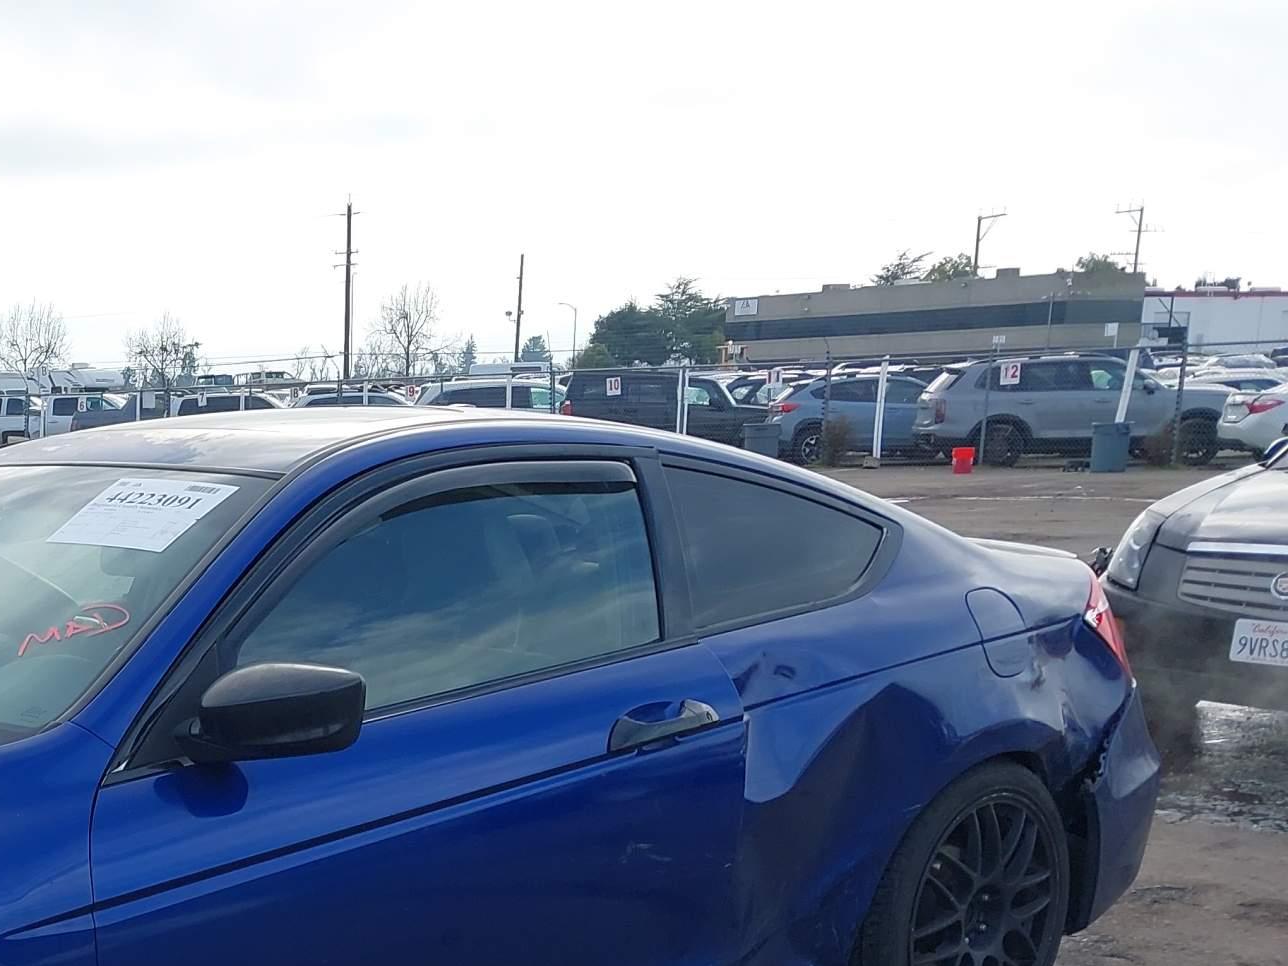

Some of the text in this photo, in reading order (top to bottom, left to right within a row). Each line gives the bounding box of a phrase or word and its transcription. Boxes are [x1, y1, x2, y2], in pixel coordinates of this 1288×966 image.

[1004, 364, 1019, 379] 12
[609, 378, 620, 391] 10
[199, 392, 205, 402] 7
[408, 386, 415, 397] 9
[79, 401, 85, 411] 6
[106, 491, 203, 510] 44223091
